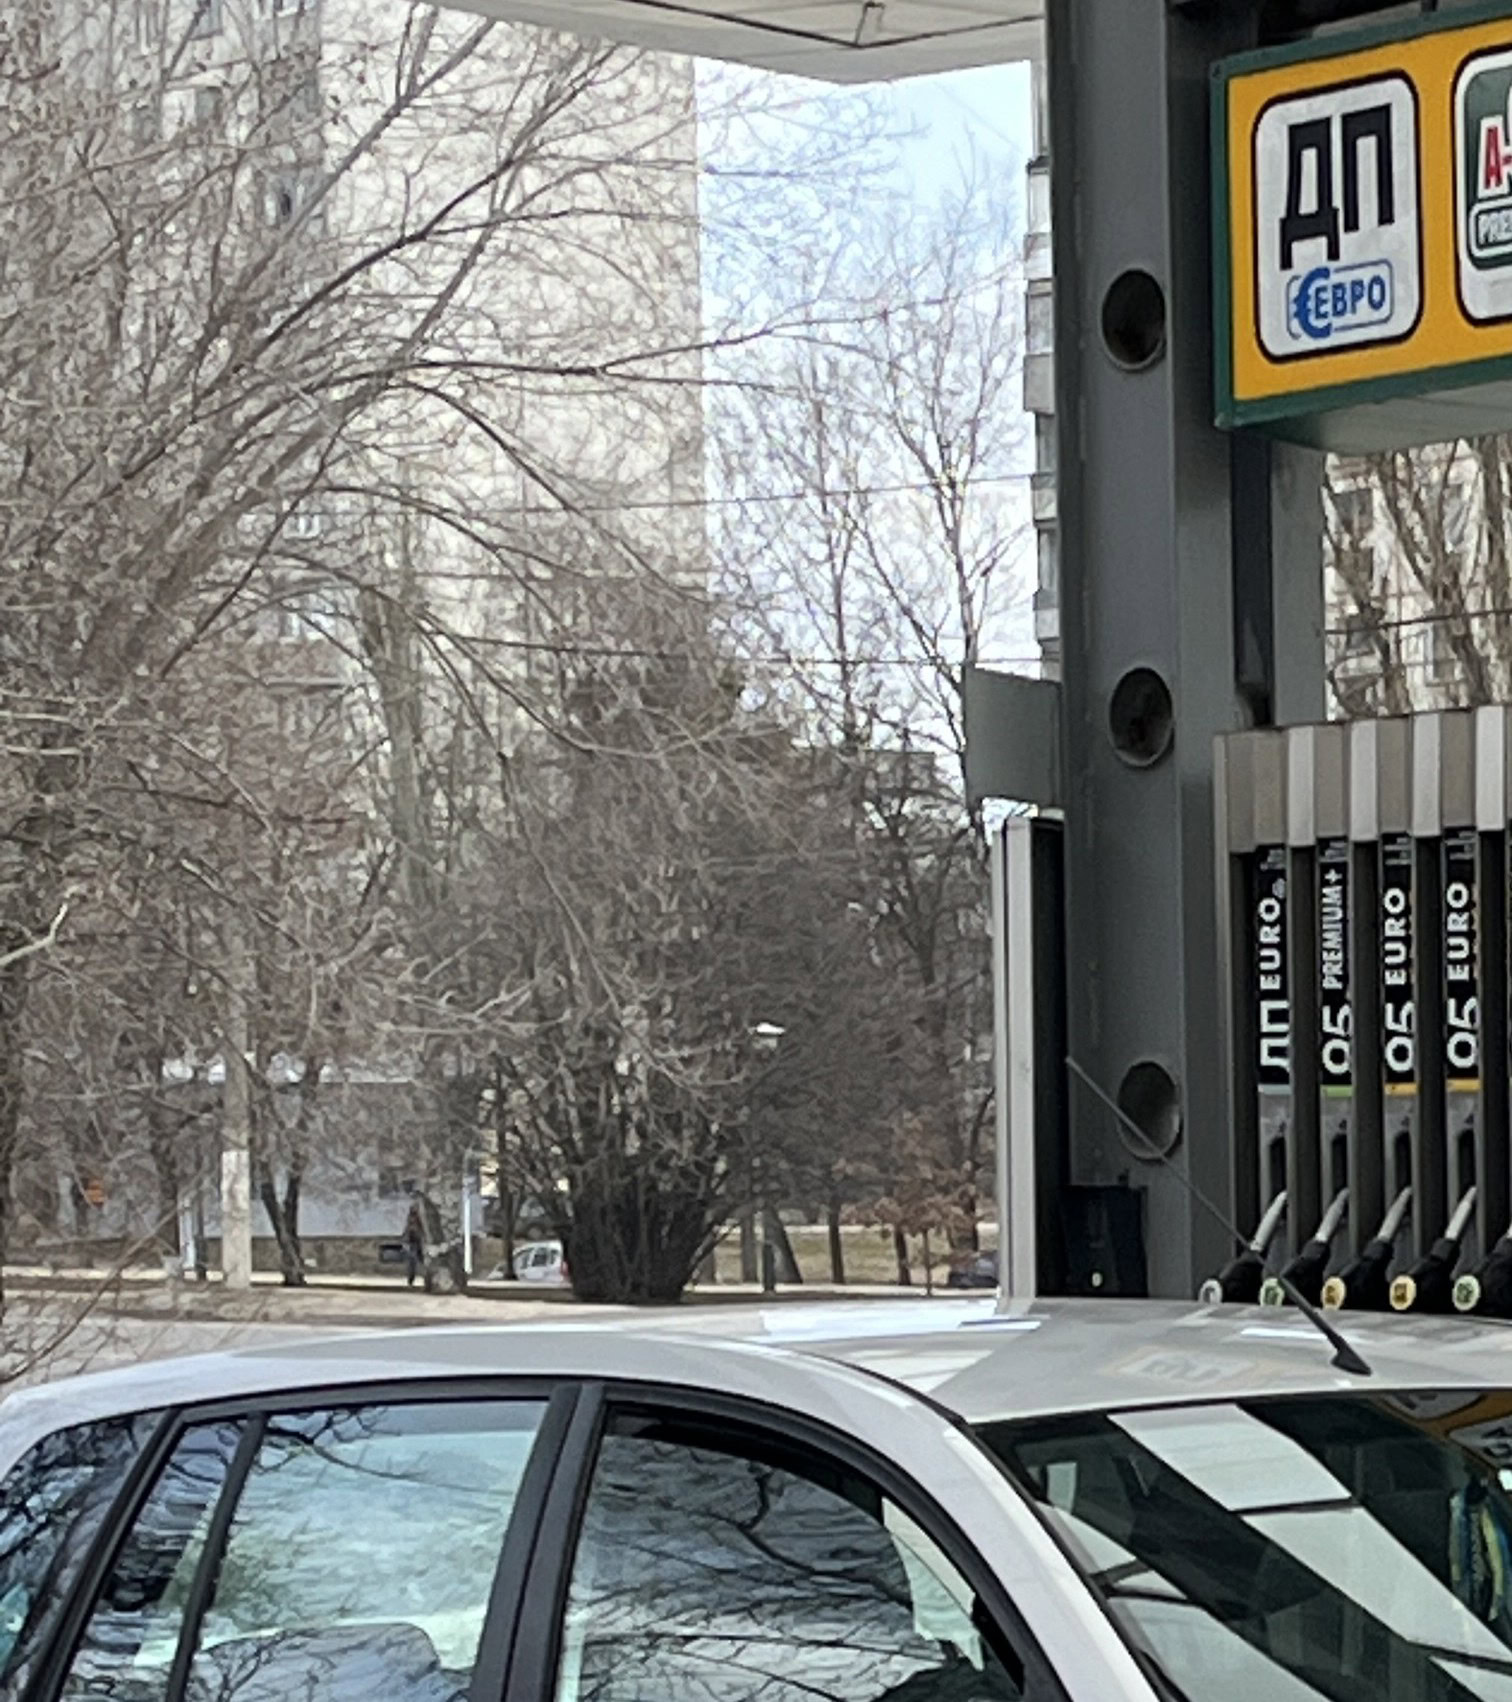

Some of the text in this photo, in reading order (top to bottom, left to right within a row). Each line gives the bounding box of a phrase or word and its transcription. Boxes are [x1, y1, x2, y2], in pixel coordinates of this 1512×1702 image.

[1280, 103, 1394, 271] ДП
[1259, 898, 1281, 990] EURO
[1322, 868, 1342, 989] PREMIUM+
[1384, 888, 1407, 985] EURO
[1446, 882, 1470, 981] EURO
